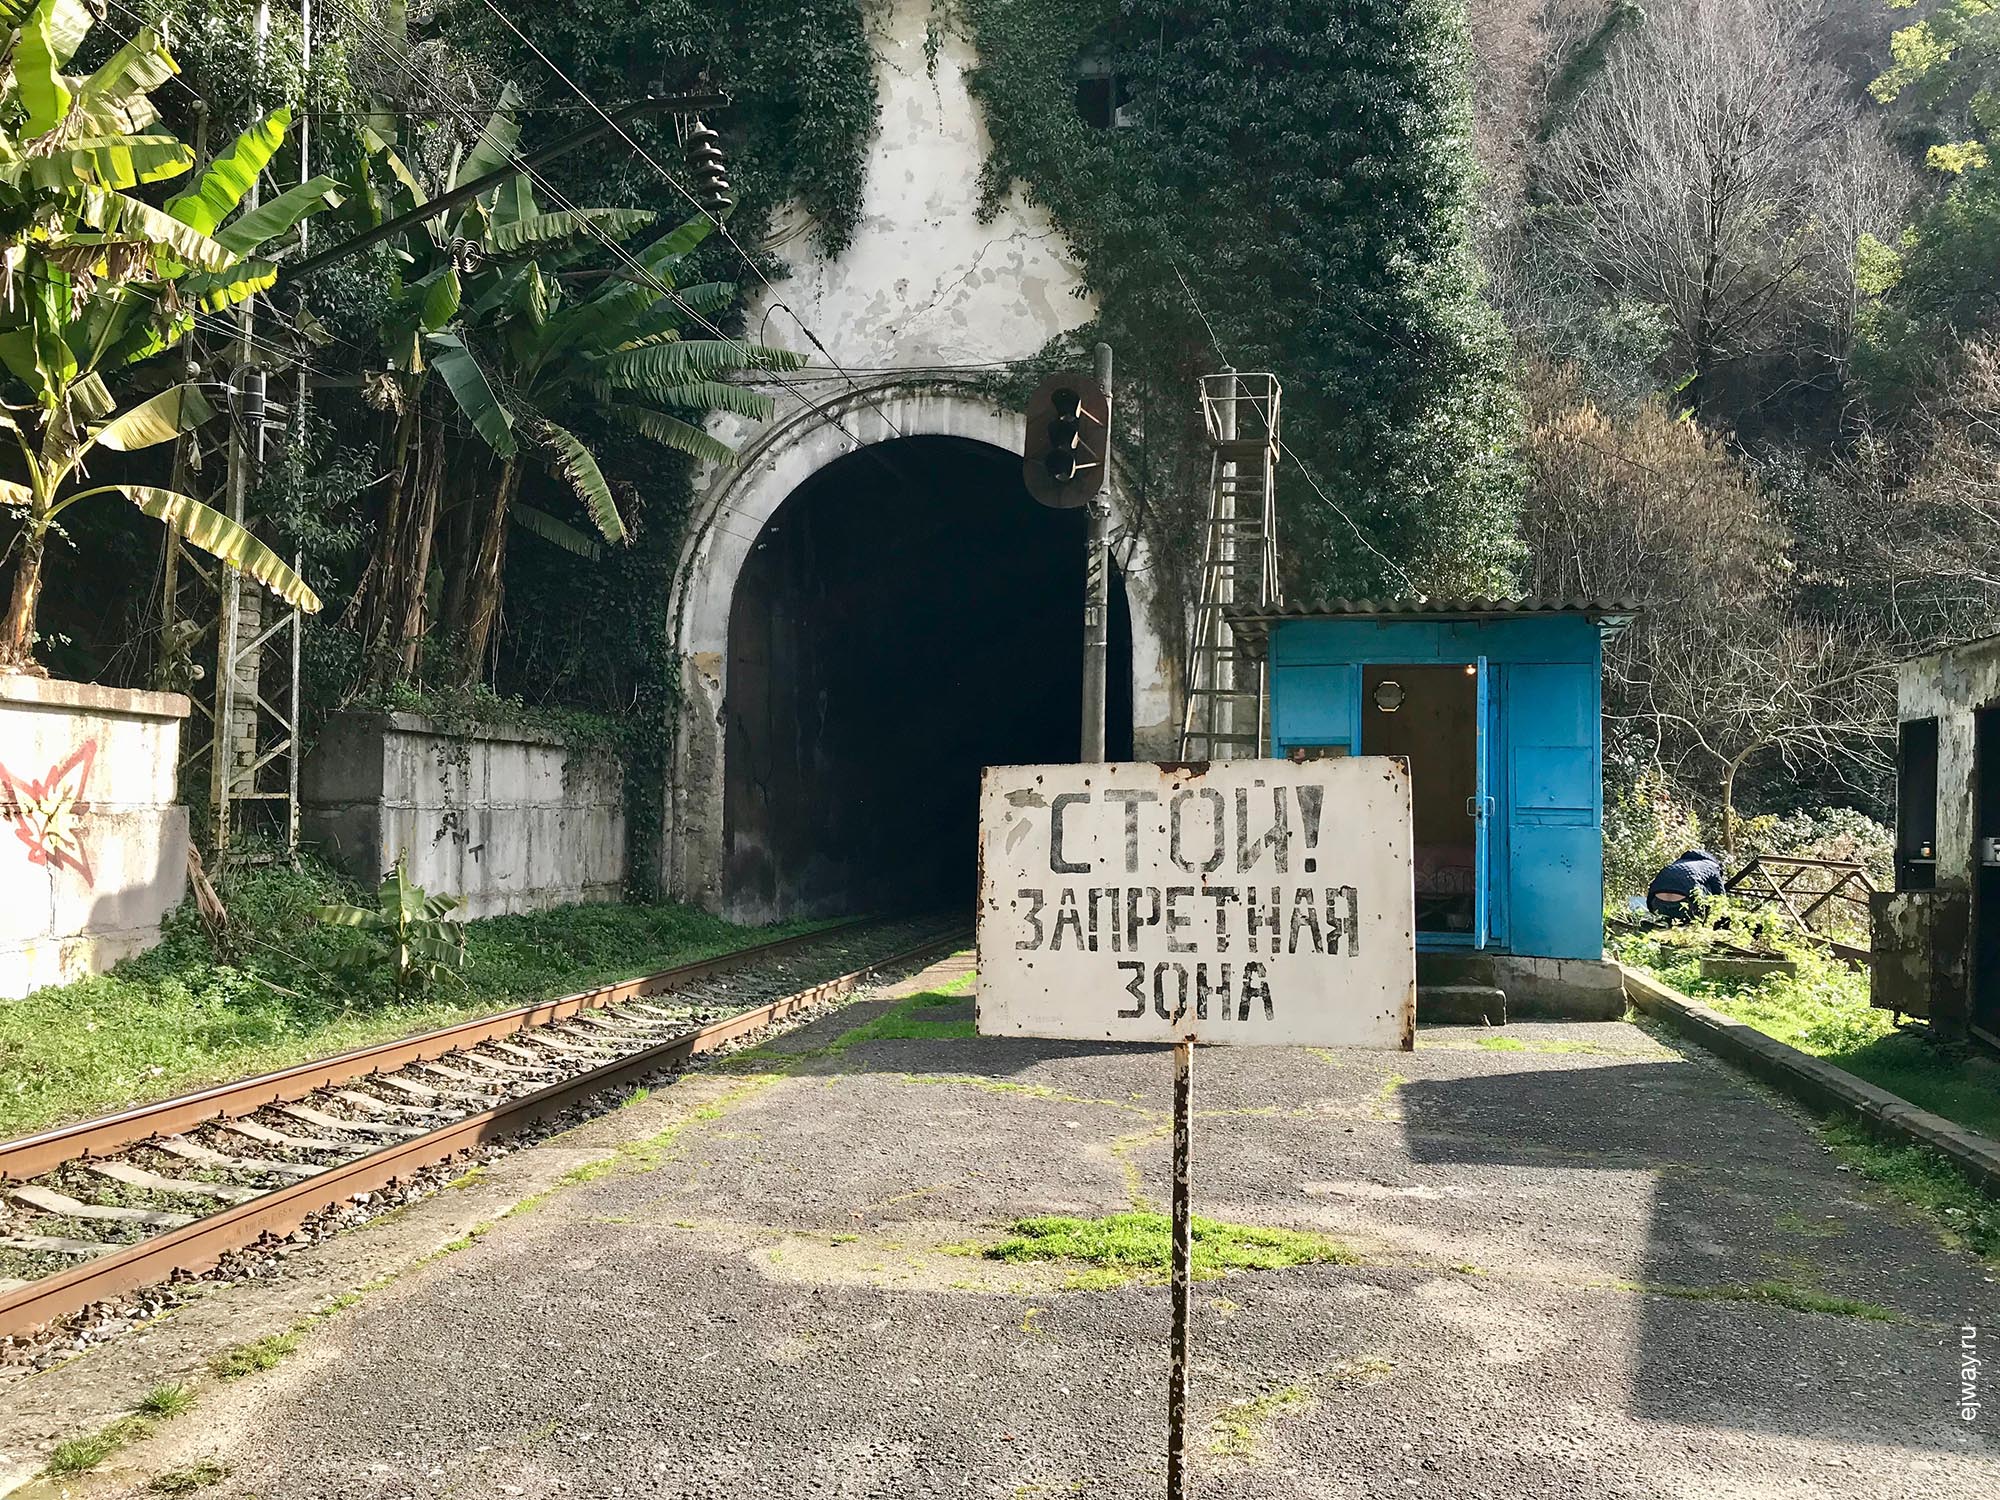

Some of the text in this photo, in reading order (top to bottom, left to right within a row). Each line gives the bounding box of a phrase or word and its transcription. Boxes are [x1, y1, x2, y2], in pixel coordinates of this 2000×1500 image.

[1050, 779, 1325, 874] СТОЙ!
[1015, 886, 1359, 957] ЗАПРЕТНАЯ
[1117, 961, 1275, 1022] ЗОНА
